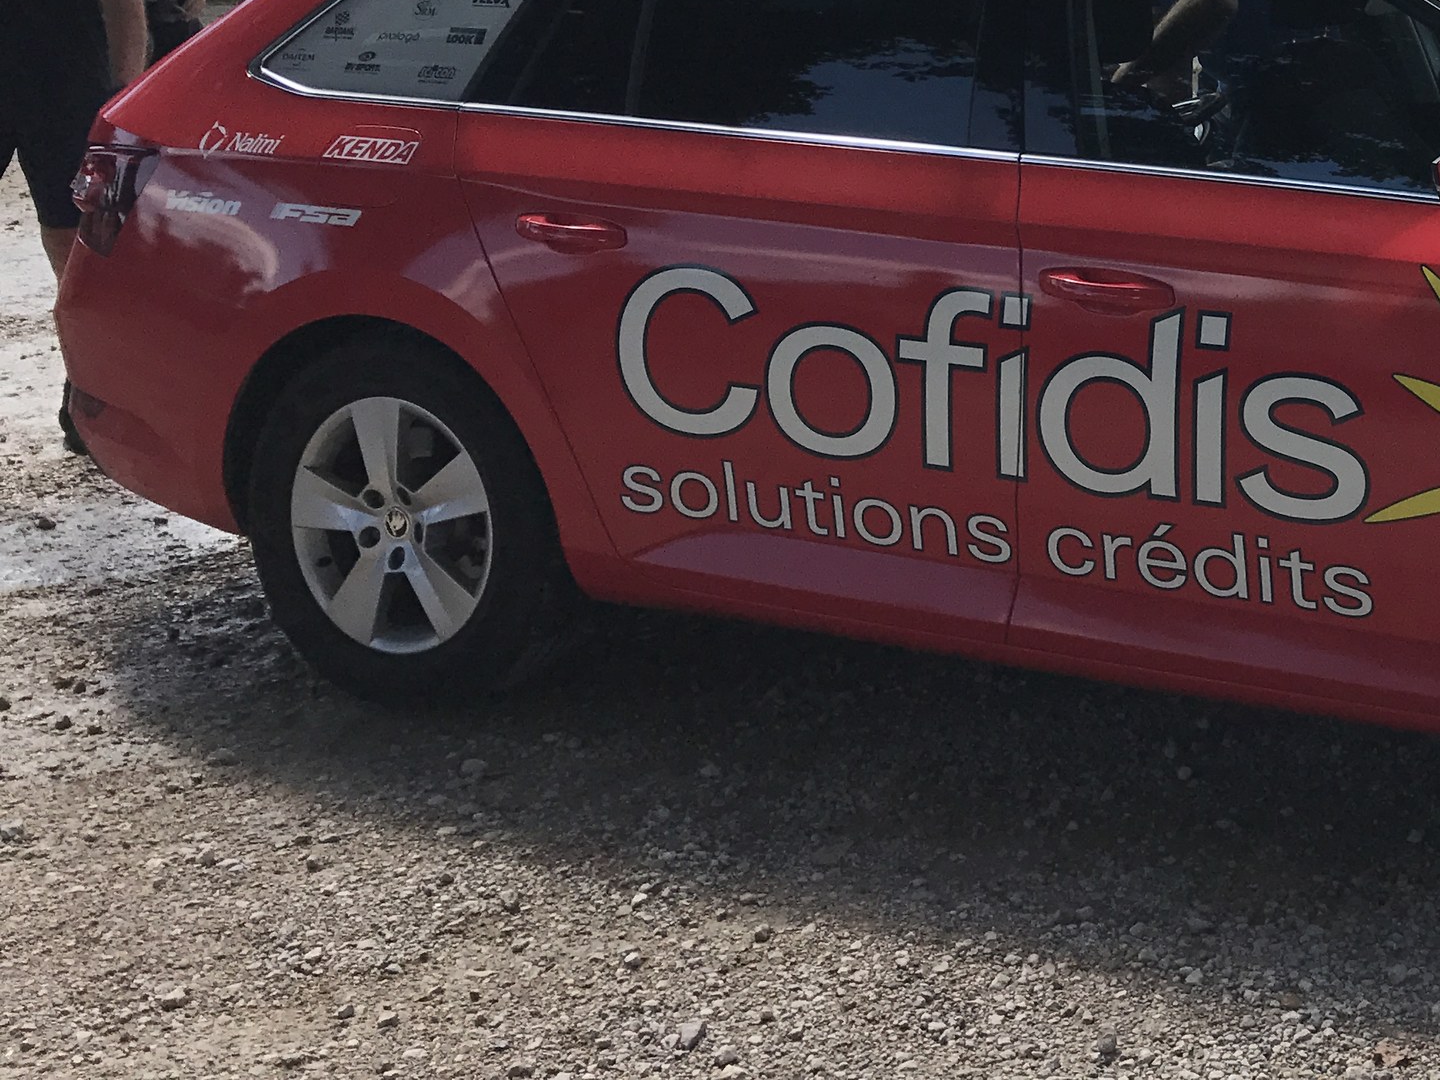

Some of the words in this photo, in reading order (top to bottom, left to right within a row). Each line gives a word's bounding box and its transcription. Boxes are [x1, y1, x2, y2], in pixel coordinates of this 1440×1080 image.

[446, 33, 474, 45] LOOK
[225, 132, 285, 155] Nalini
[325, 135, 418, 165] KENDA
[165, 189, 241, 216] Vision
[615, 263, 1372, 524] Cofidis
[620, 460, 1012, 565] solutions
[1046, 522, 1375, 619] crédits
